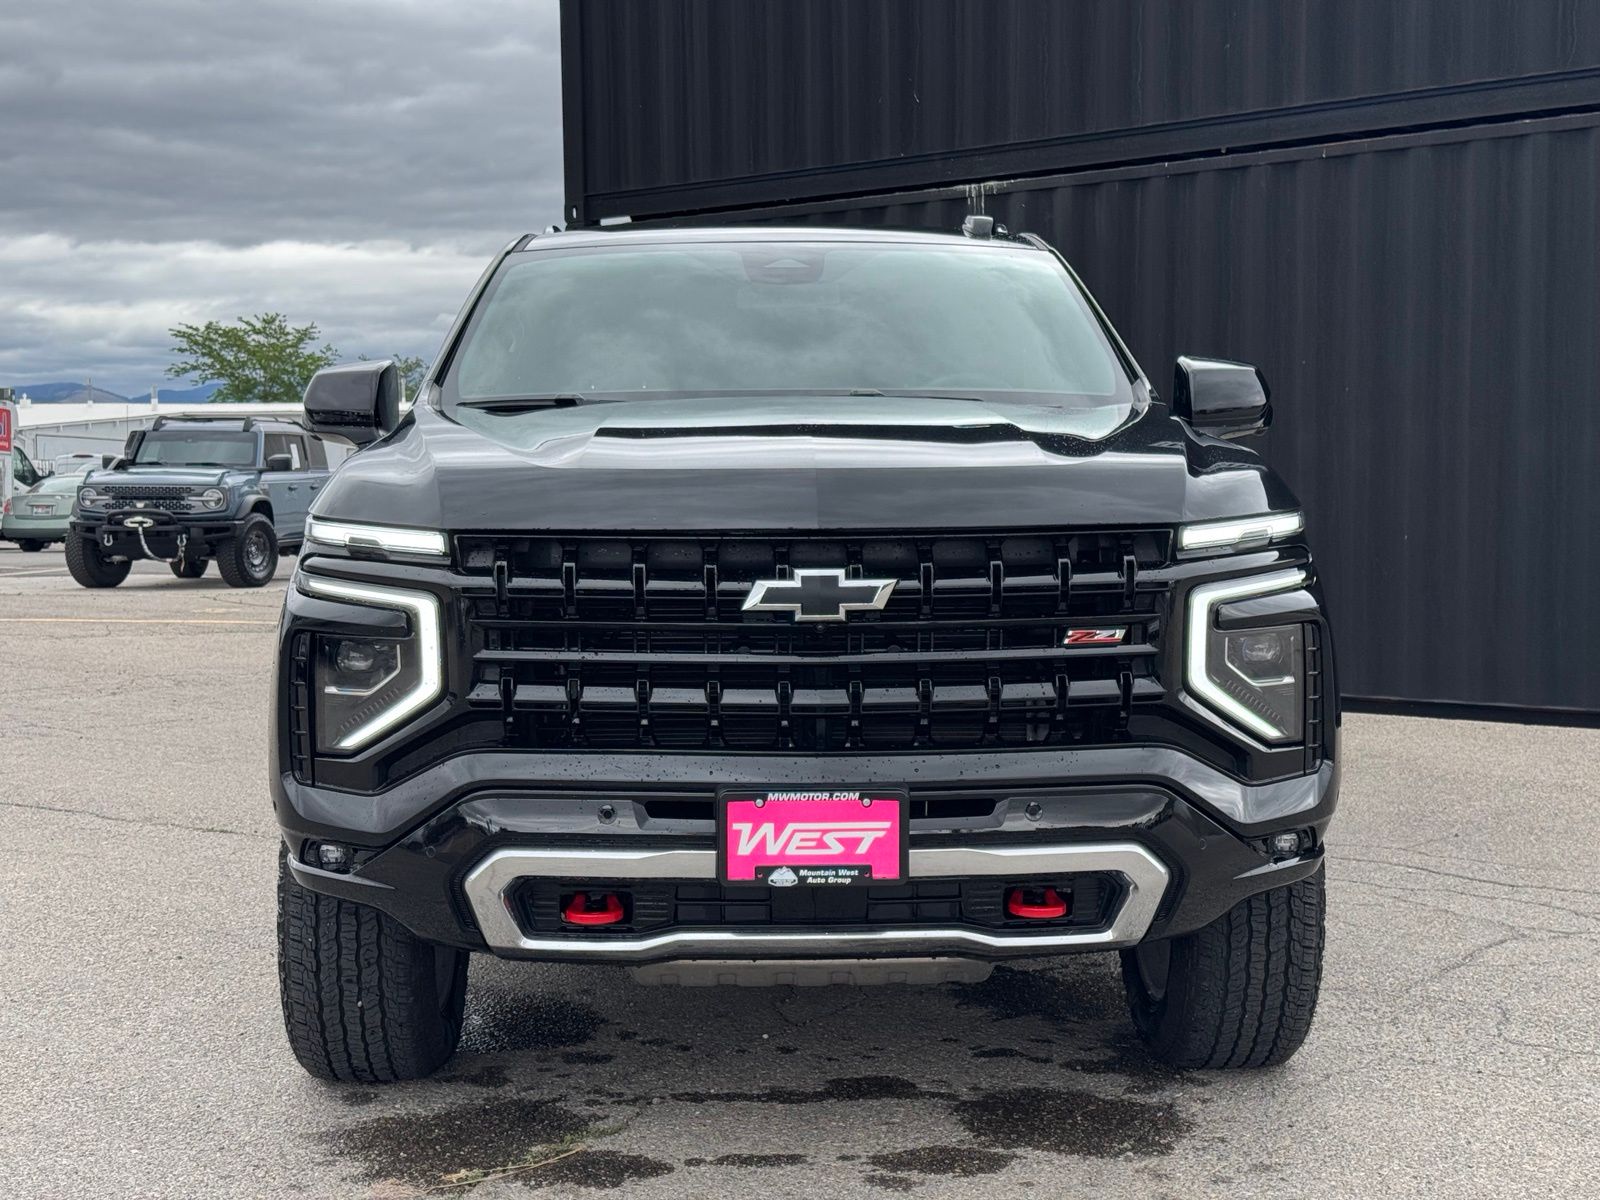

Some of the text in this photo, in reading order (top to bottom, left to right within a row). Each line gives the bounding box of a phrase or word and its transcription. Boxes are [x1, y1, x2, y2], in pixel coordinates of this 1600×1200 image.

[1063, 629, 1126, 645] Z71
[767, 792, 860, 802] MWMOTOR.COM
[732, 821, 892, 856] WEST
[799, 869, 859, 877] Mountain West
[807, 876, 852, 885] Auto Group
